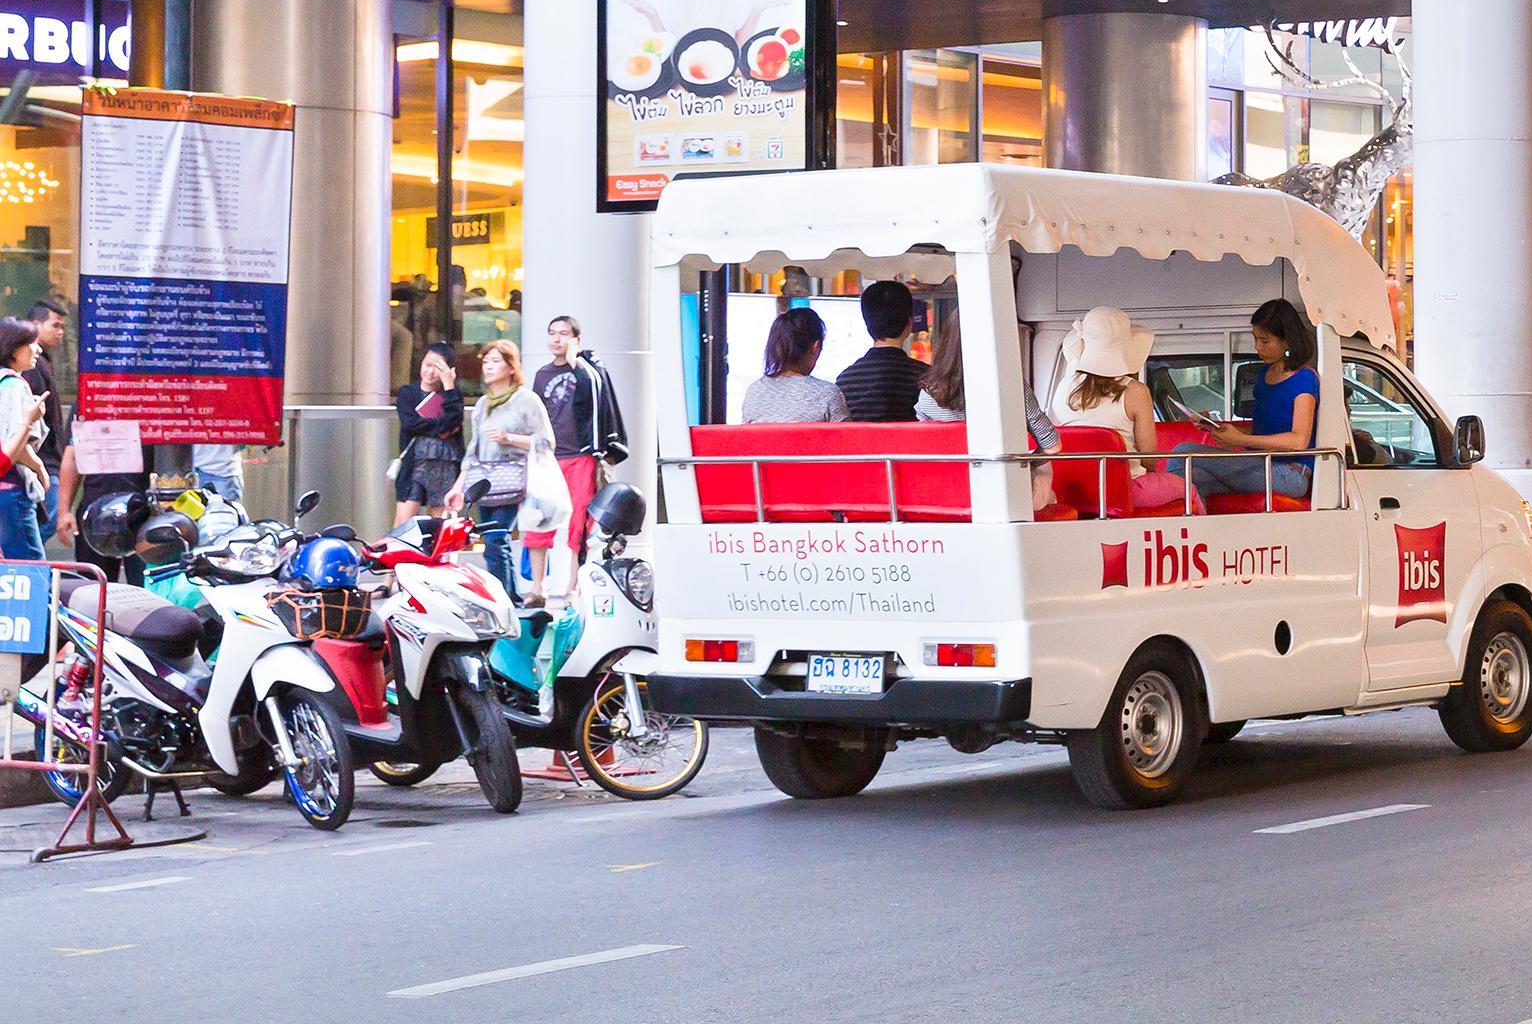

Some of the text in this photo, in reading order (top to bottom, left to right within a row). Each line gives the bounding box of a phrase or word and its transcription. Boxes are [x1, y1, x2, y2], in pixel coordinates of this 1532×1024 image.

[671, 92, 724, 116] ไข่ลวก
[733, 95, 795, 118] ยางมะตูม
[616, 179, 638, 192] Easy
[708, 530, 945, 560] ibis Bangkok Sathorn
[1143, 528, 1288, 592] ibis HOTEL
[1403, 550, 1440, 591] ibis
[739, 562, 912, 585] T +66 (0) 2610 5188
[728, 591, 936, 615] ibishotel.com/Thailand
[841, 658, 881, 679] 8132
